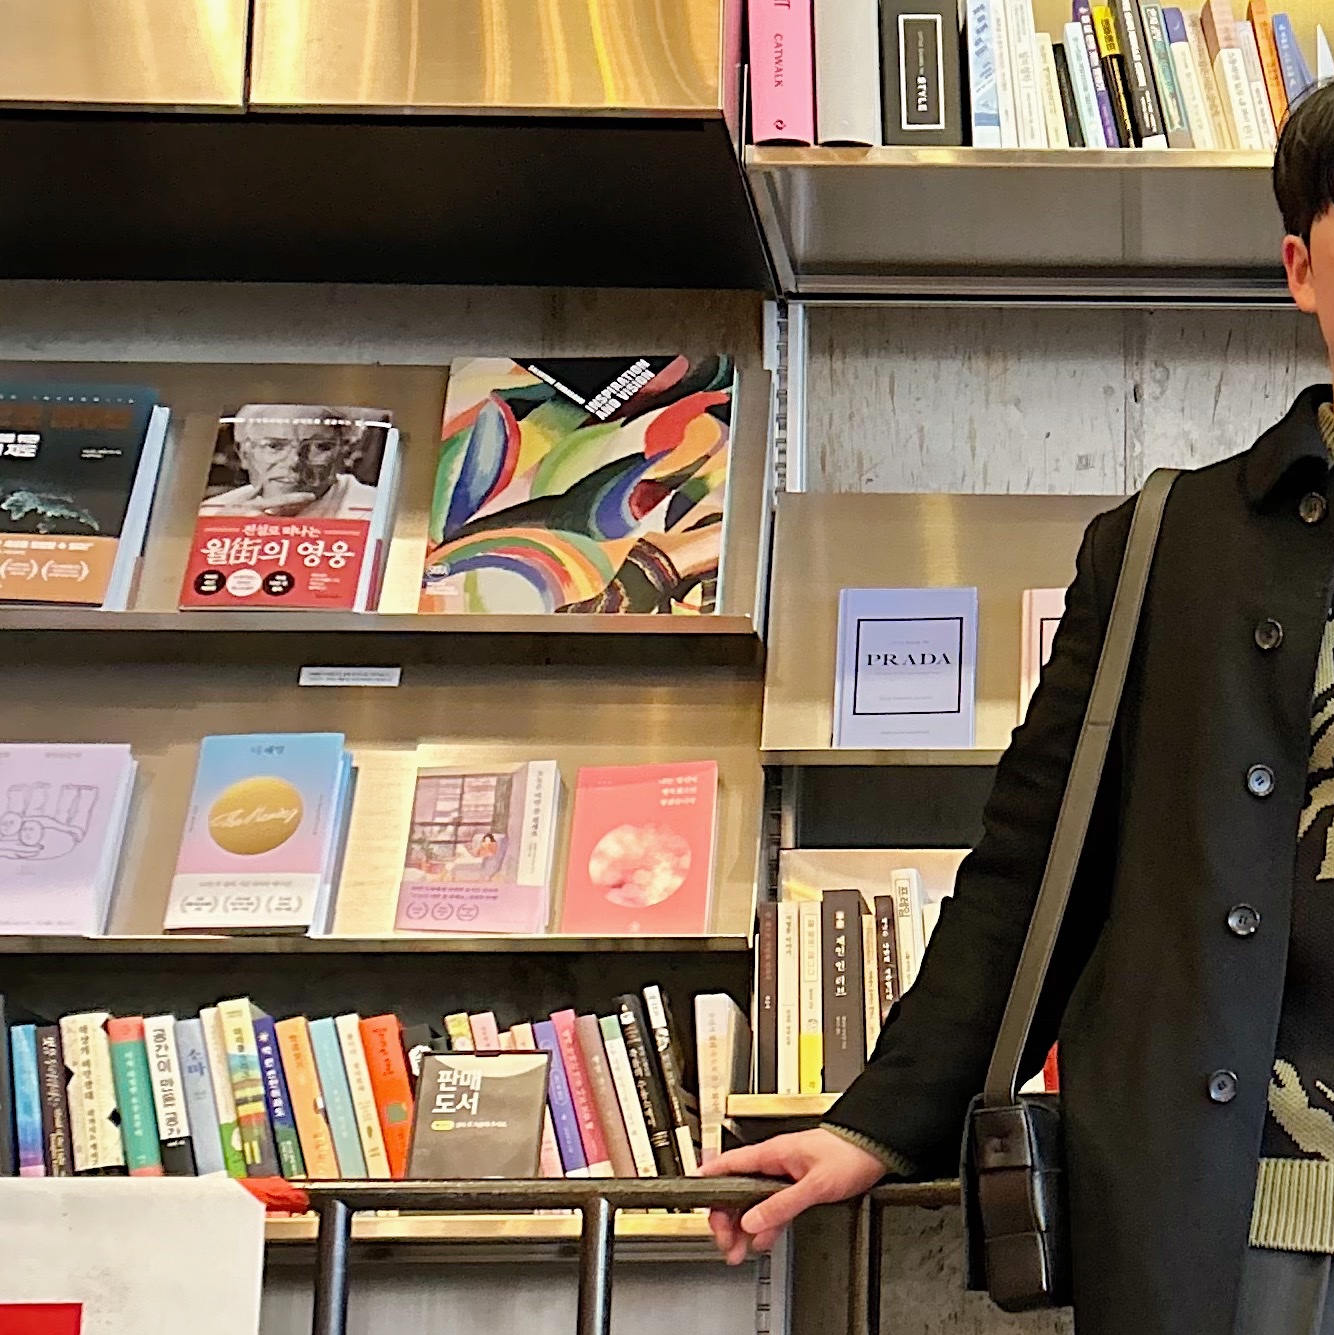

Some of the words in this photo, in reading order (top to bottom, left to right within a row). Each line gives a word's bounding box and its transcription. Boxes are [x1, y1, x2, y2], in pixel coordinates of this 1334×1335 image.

[773, 33, 784, 88] CATWALK
[917, 76, 928, 112] STYLE
[584, 358, 651, 413] INSPIRATION
[595, 398, 622, 421] AND
[616, 369, 656, 401] VISION
[297, 539, 356, 569] 영웅
[867, 653, 951, 666] PRADA
[437, 1069, 483, 1092] 판매
[431, 1092, 480, 1115] 도서
